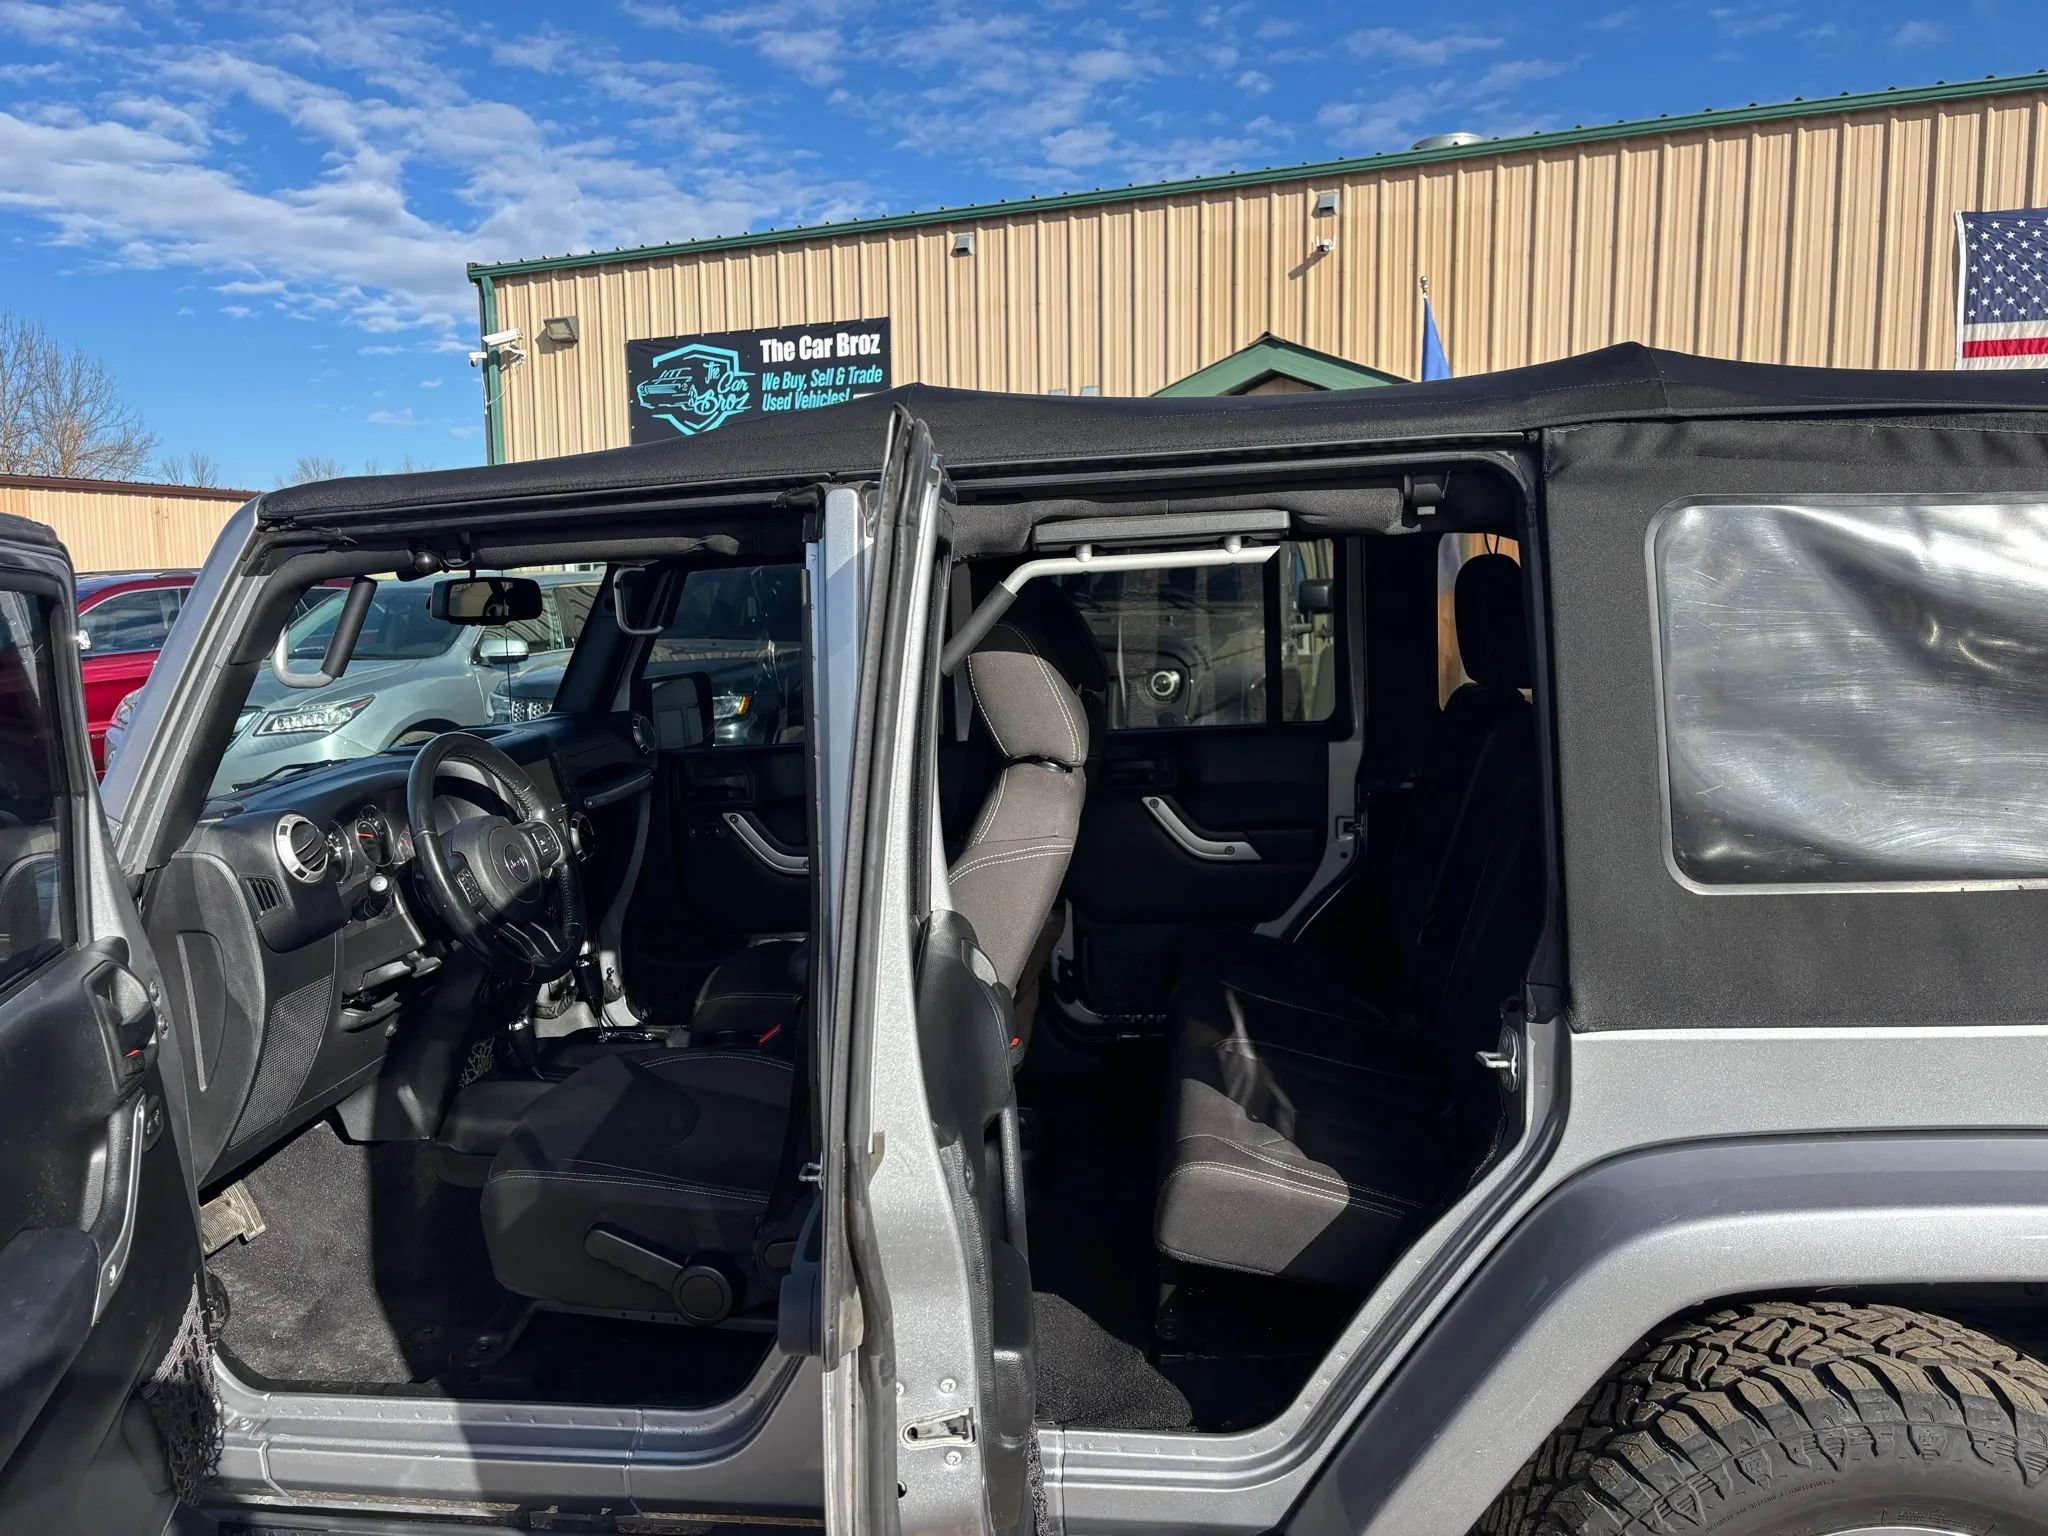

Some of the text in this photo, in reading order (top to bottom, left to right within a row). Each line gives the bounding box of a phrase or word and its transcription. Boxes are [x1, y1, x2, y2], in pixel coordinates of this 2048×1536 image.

[760, 332, 881, 363] The Car Broz
[717, 371, 749, 394] Car
[762, 364, 883, 391] We Buy, Sell & Trade
[762, 391, 793, 412] Used
